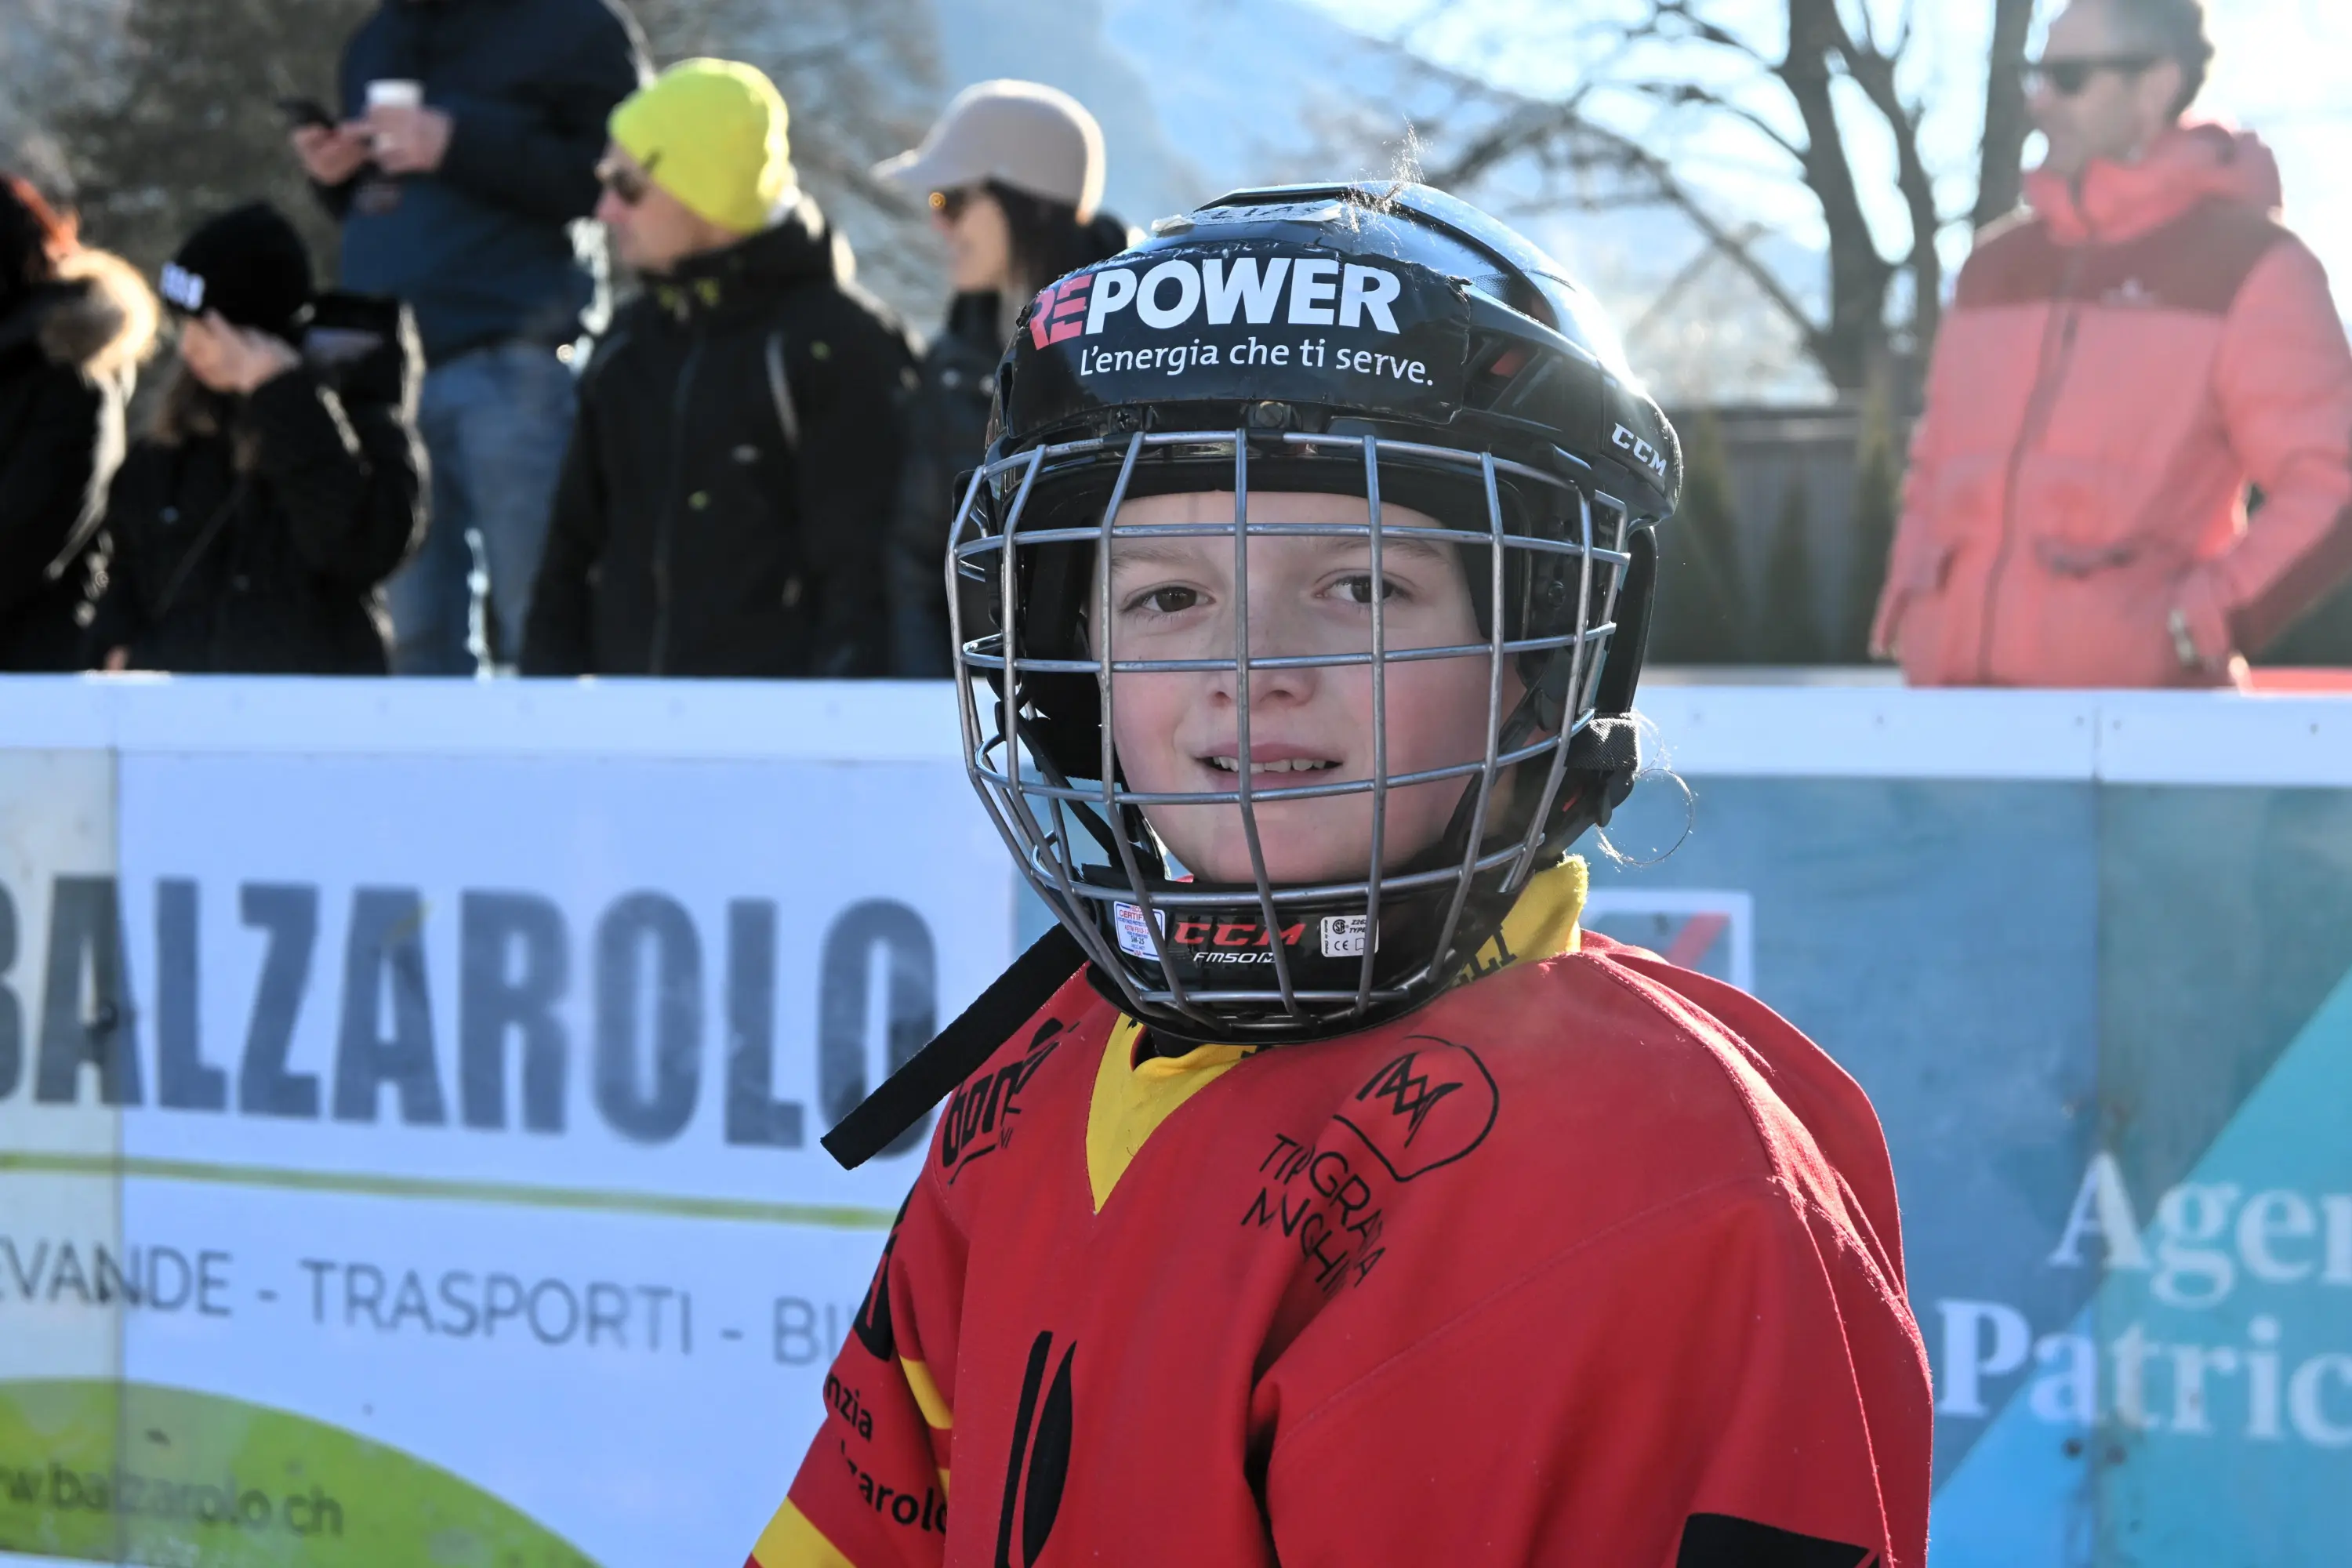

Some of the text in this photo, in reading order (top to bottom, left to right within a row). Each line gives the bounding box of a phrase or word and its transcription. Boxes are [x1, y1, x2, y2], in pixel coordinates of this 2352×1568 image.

[1029, 257, 1400, 350] REPOWER
[1080, 336, 1434, 386] L'energia che ti serve.
[1612, 422, 1667, 477] CCM
[1174, 922, 1307, 946] CCM
[1334, 940, 1349, 951] CE
[0, 873, 938, 1162] ALZAROLO
[0, 1236, 234, 1317] VANDE
[298, 1258, 694, 1356] TRASPORTI
